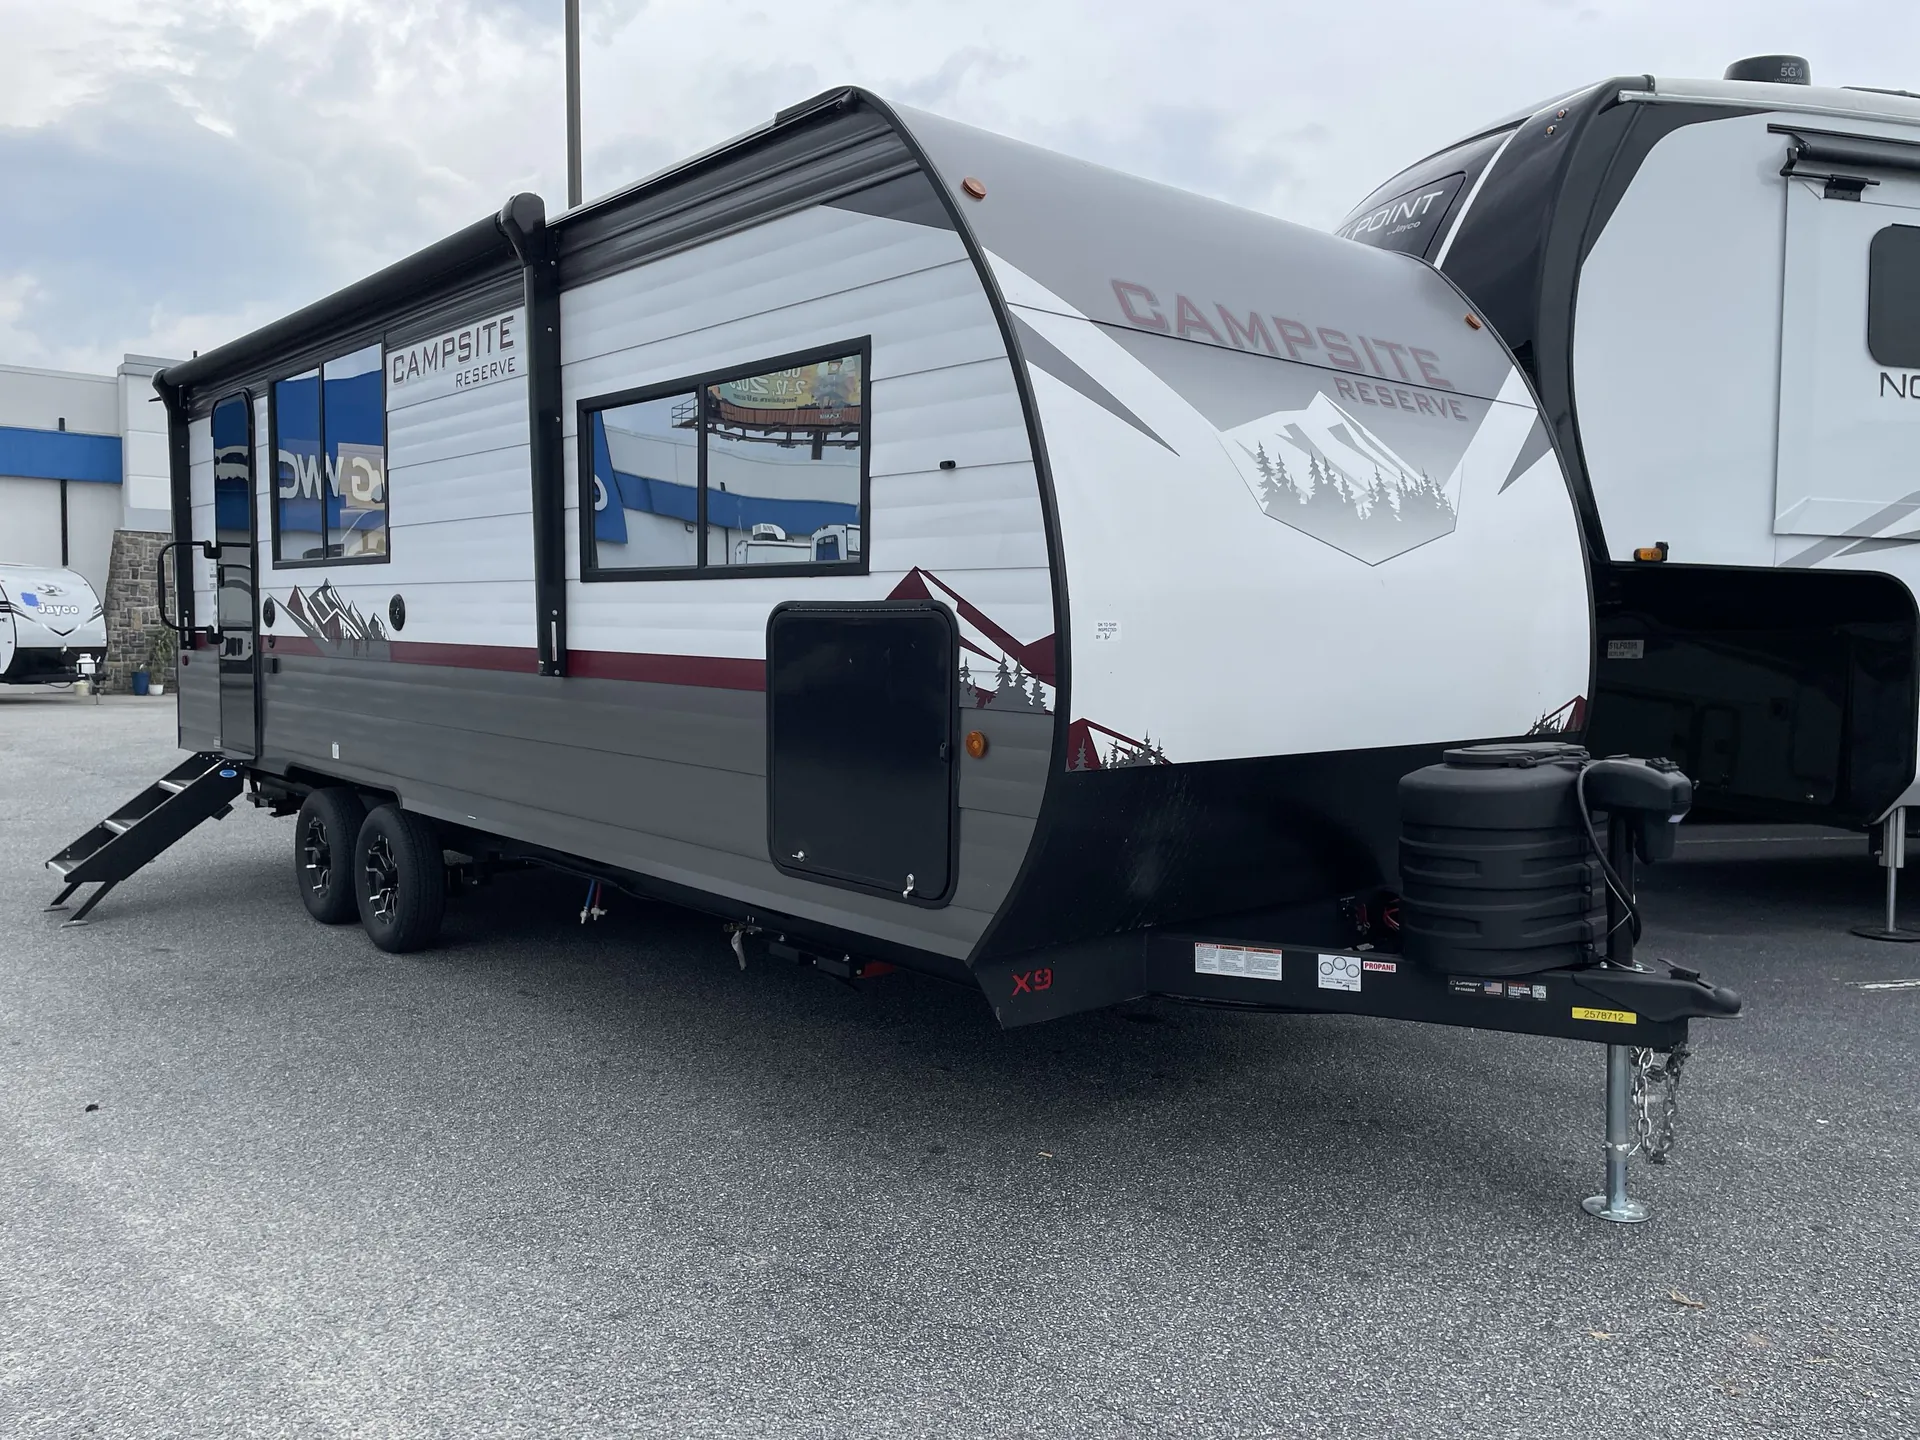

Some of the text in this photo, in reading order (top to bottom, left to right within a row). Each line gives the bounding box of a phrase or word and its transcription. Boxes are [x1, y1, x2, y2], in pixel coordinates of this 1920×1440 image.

[1780, 67, 1796, 77] 5G
[1351, 191, 1444, 240] POINT
[1391, 221, 1421, 234] Jayco
[1111, 278, 1456, 389] CAMPSITE
[393, 315, 514, 384] CAMPSITE
[456, 357, 516, 387] RESERVE
[1333, 377, 1470, 421] RESERVE
[37, 602, 79, 616] Jayco
[1364, 962, 1395, 972] PROPANE
[1012, 968, 1053, 996] X9
[1584, 1010, 1625, 1021] 2578712
